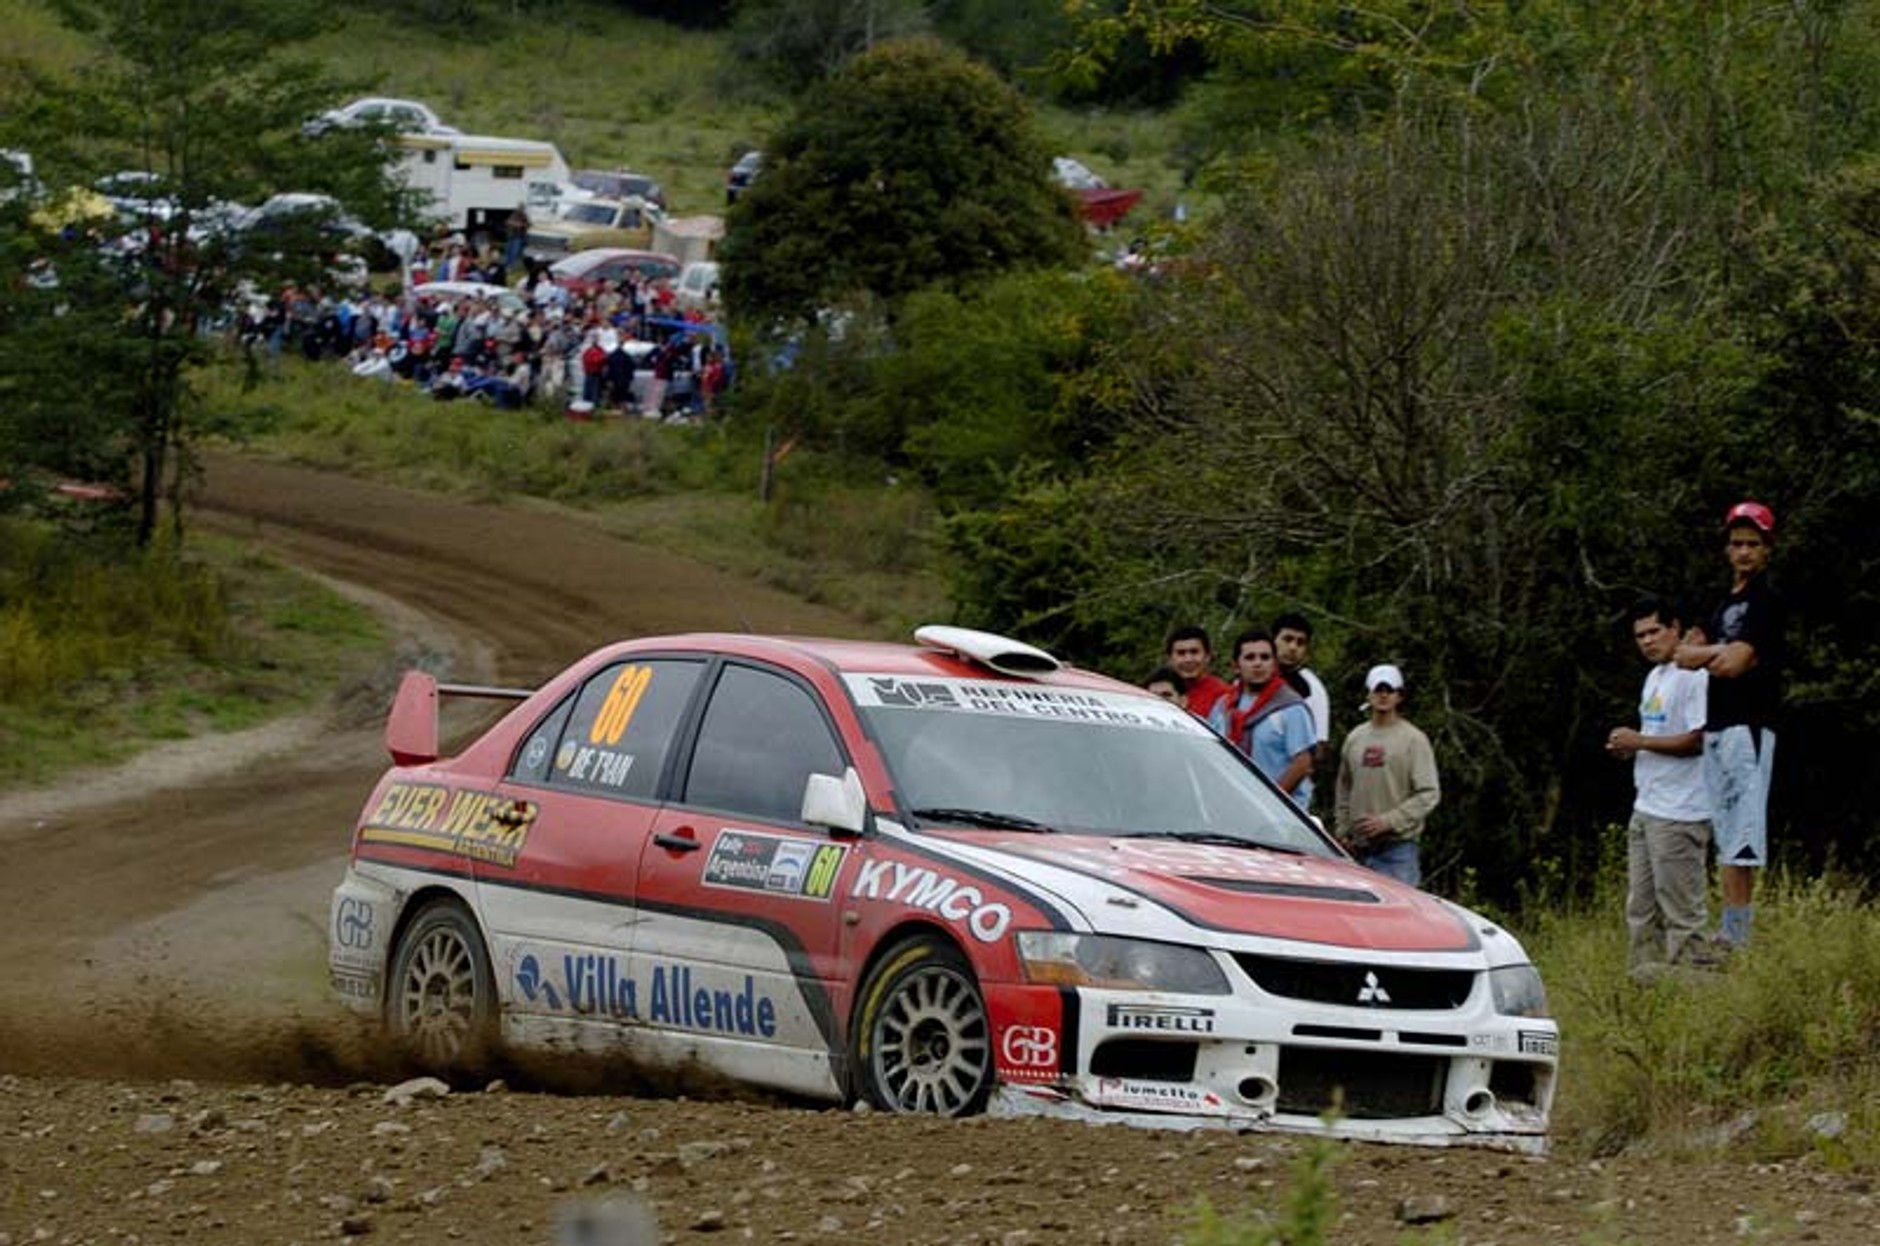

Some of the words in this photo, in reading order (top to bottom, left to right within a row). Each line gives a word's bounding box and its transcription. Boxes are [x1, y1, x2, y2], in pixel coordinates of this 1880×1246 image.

[589, 664, 653, 746] 60
[367, 783, 448, 829] EVER
[806, 845, 841, 896] 60
[852, 858, 1012, 942] KYMCO
[563, 954, 640, 1021] Villa
[650, 964, 777, 1038] Allende
[1106, 1003, 1214, 1032] PIRELLI
[1002, 1024, 1057, 1067] GB
